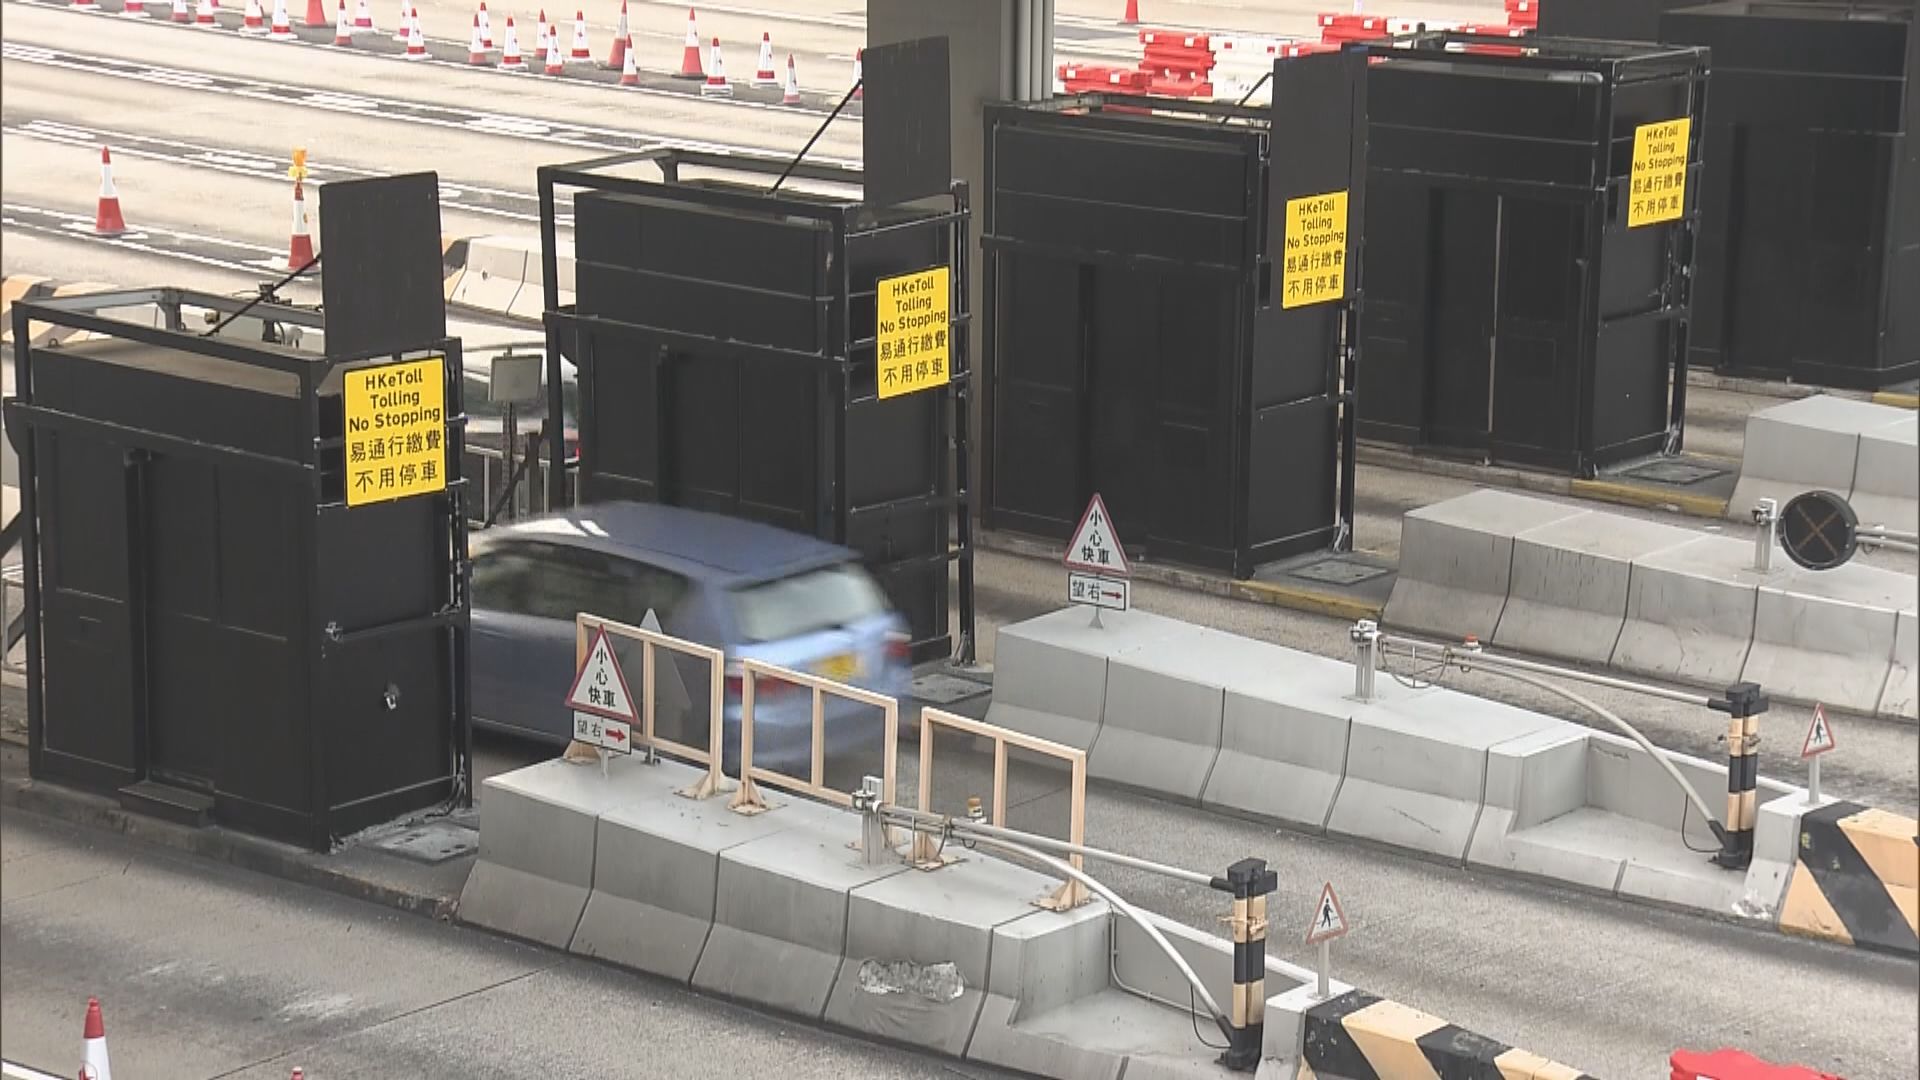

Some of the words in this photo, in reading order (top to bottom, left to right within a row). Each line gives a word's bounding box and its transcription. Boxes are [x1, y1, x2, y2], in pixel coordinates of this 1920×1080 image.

[1634, 161, 1645, 172] No
[1299, 198, 1334, 215] HKeToll
[1302, 217, 1332, 232] Tolling
[1287, 237, 1299, 249] No
[1304, 230, 1344, 247] Stopping
[893, 276, 934, 296] HKeToll
[896, 296, 931, 313] Tolling
[880, 321, 894, 334] No
[899, 310, 946, 330] Stopping
[366, 368, 423, 390] HKeToll
[884, 358, 943, 387] 不用停車
[370, 391, 420, 409] Tolling
[350, 417, 369, 433] No
[375, 407, 440, 428] Stopping
[351, 430, 441, 463] 易通行繳費
[355, 460, 437, 493] 不用停車
[588, 686, 615, 708] 快車
